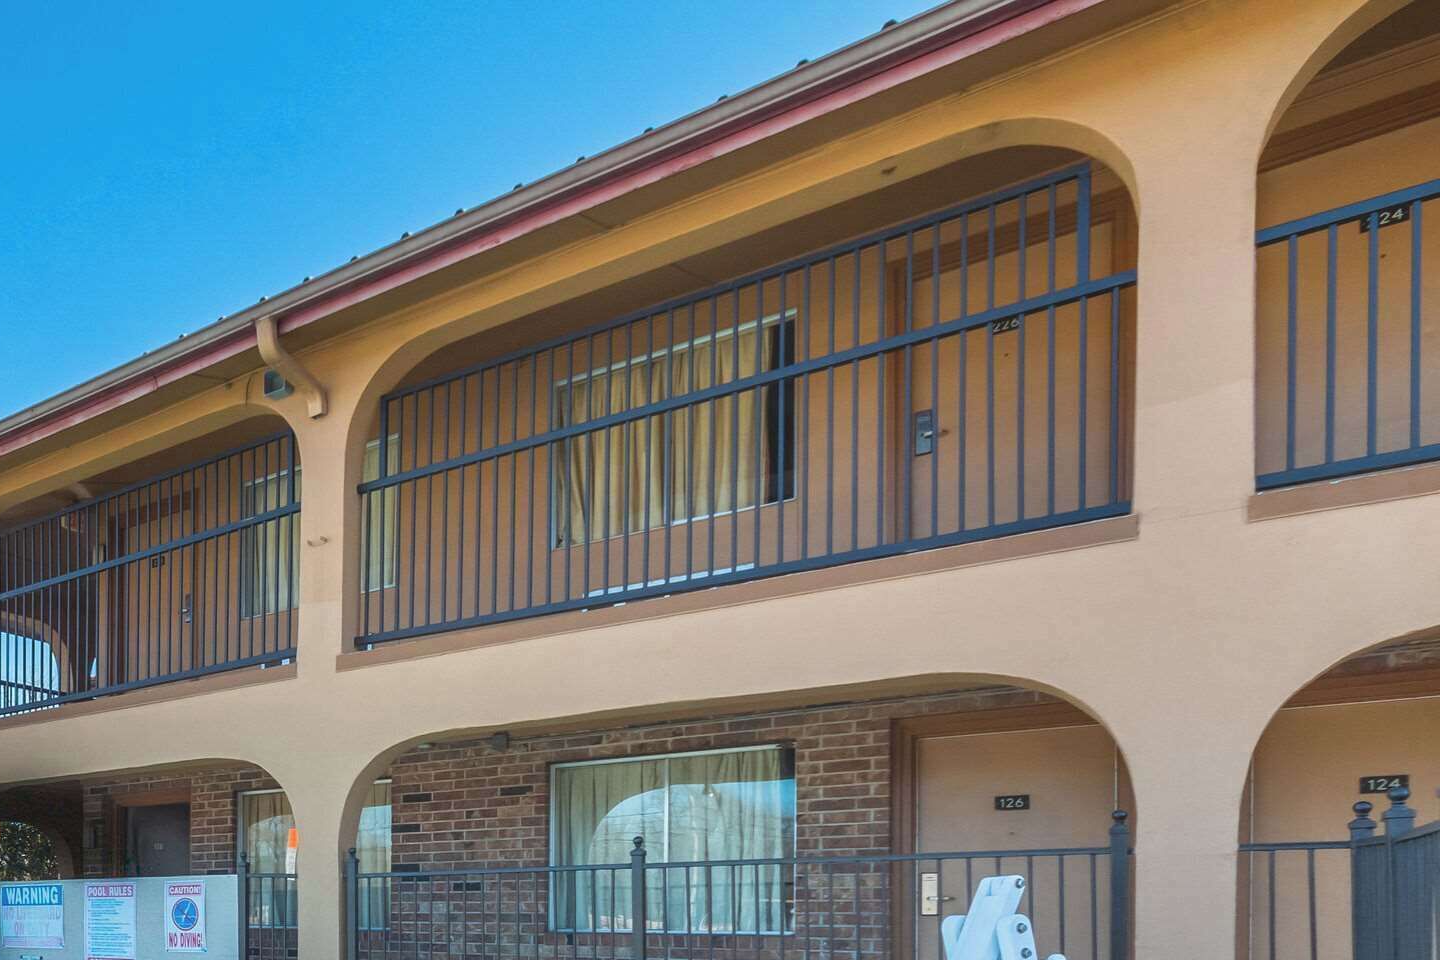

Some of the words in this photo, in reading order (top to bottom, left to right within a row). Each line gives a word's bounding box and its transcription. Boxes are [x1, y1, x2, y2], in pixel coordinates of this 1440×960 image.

[1367, 778, 1401, 791] 124
[1000, 798, 1024, 808] 126
[6, 887, 58, 905] WARNING
[88, 886, 107, 897] POOL
[108, 886, 133, 896] RULES
[168, 932, 178, 948] NO
